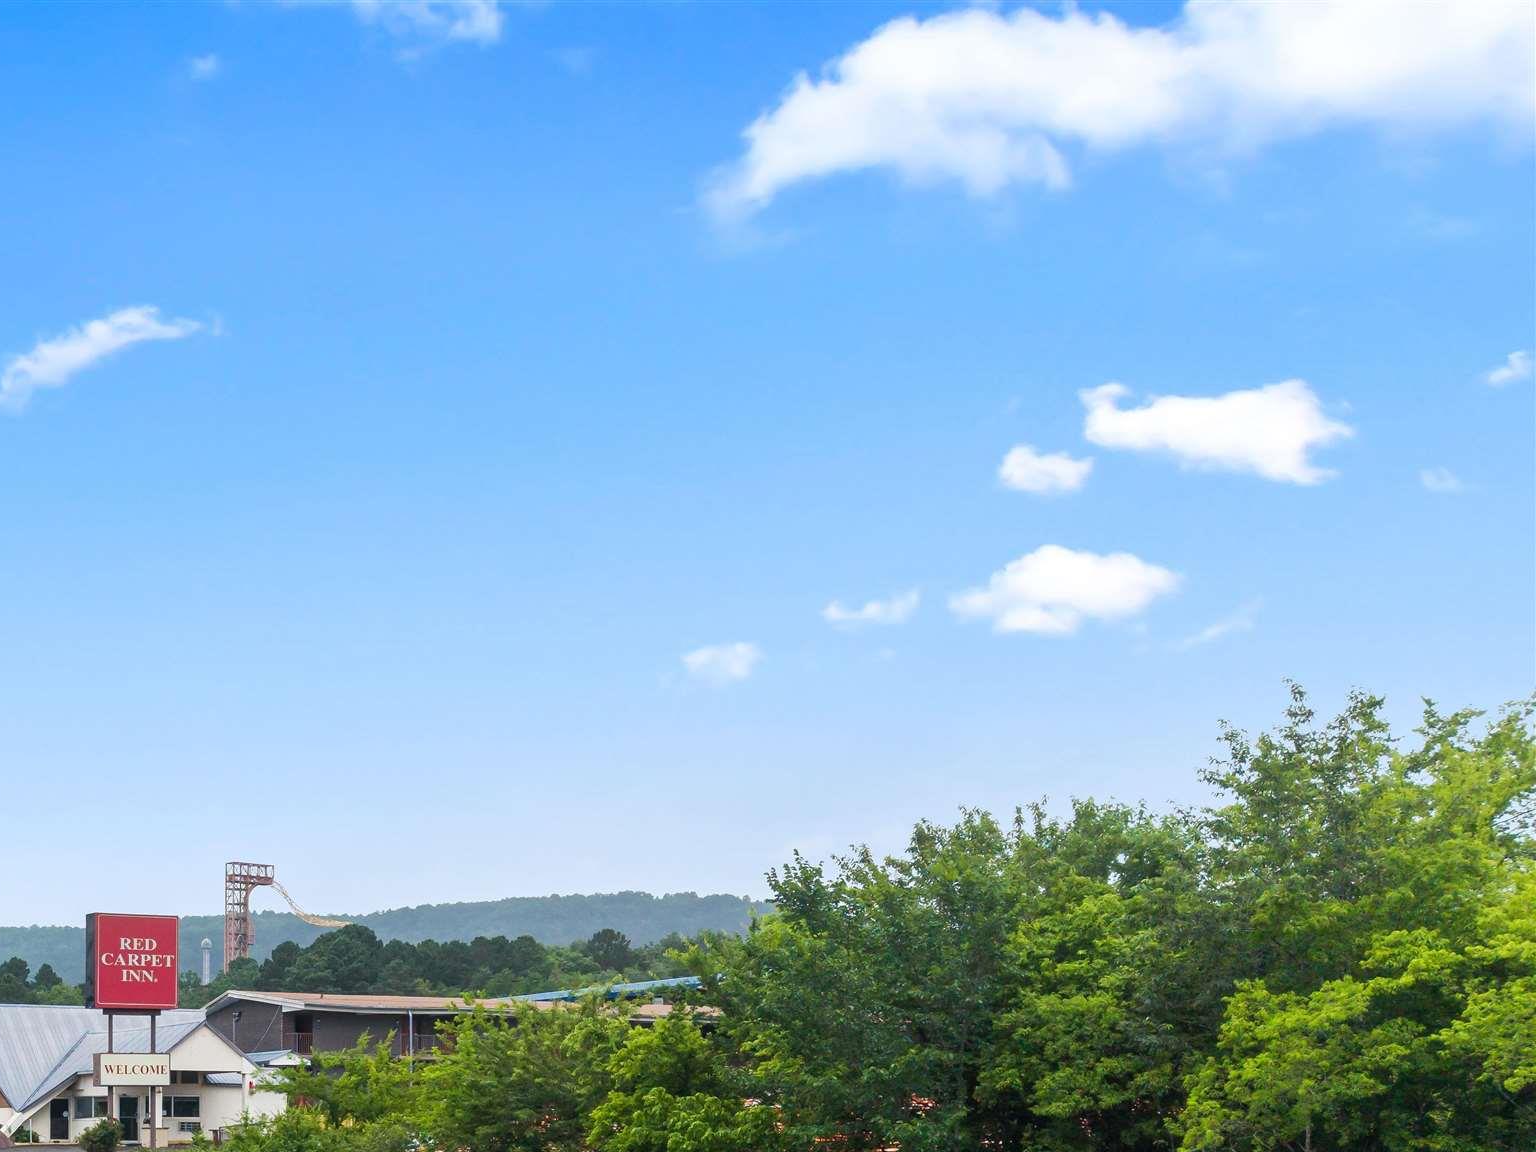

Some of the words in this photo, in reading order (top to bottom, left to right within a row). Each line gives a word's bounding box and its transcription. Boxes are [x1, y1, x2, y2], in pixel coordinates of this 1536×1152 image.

[119, 937, 157, 951] RED
[101, 952, 175, 968] CARPET
[120, 969, 158, 983] INN.
[104, 1064, 167, 1075] WELCOME
